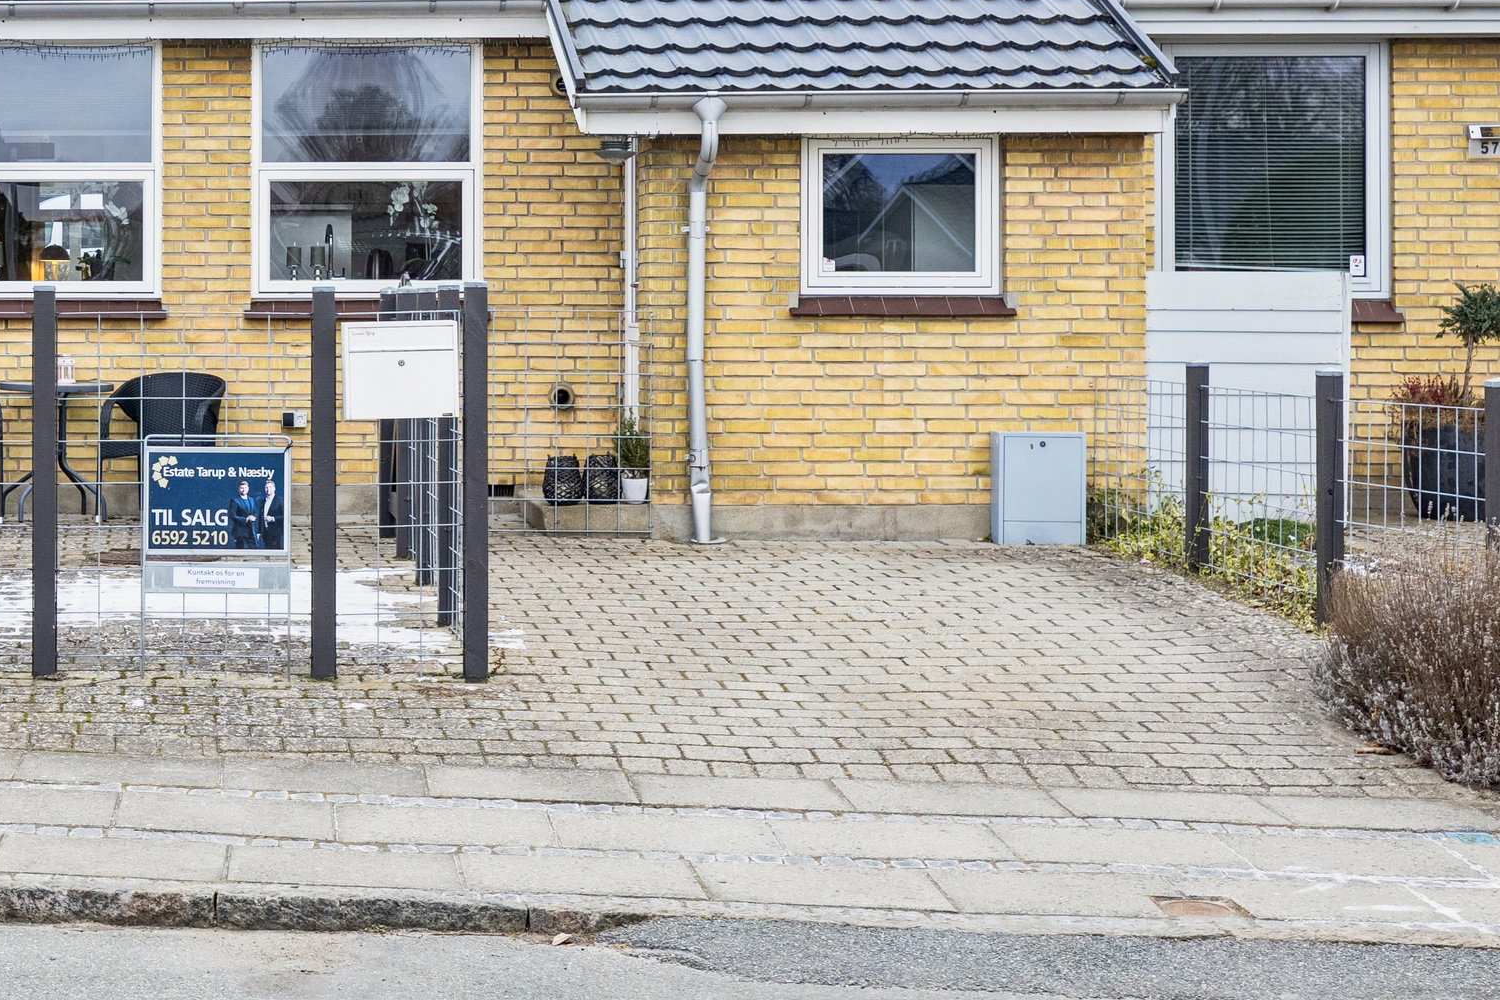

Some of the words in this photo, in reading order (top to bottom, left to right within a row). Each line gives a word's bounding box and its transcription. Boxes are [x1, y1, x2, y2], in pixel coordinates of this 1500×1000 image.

[1481, 141, 1499, 154] 57
[163, 466, 195, 477] Estate
[197, 466, 226, 479] Tarup
[227, 466, 237, 477] &
[238, 466, 275, 479] Næsby
[151, 508, 178, 526] TIL
[181, 508, 229, 526] SALG
[151, 530, 188, 545] 6592
[192, 530, 229, 545] 5210
[224, 569, 235, 577] for
[195, 578, 236, 586] fremvisning
